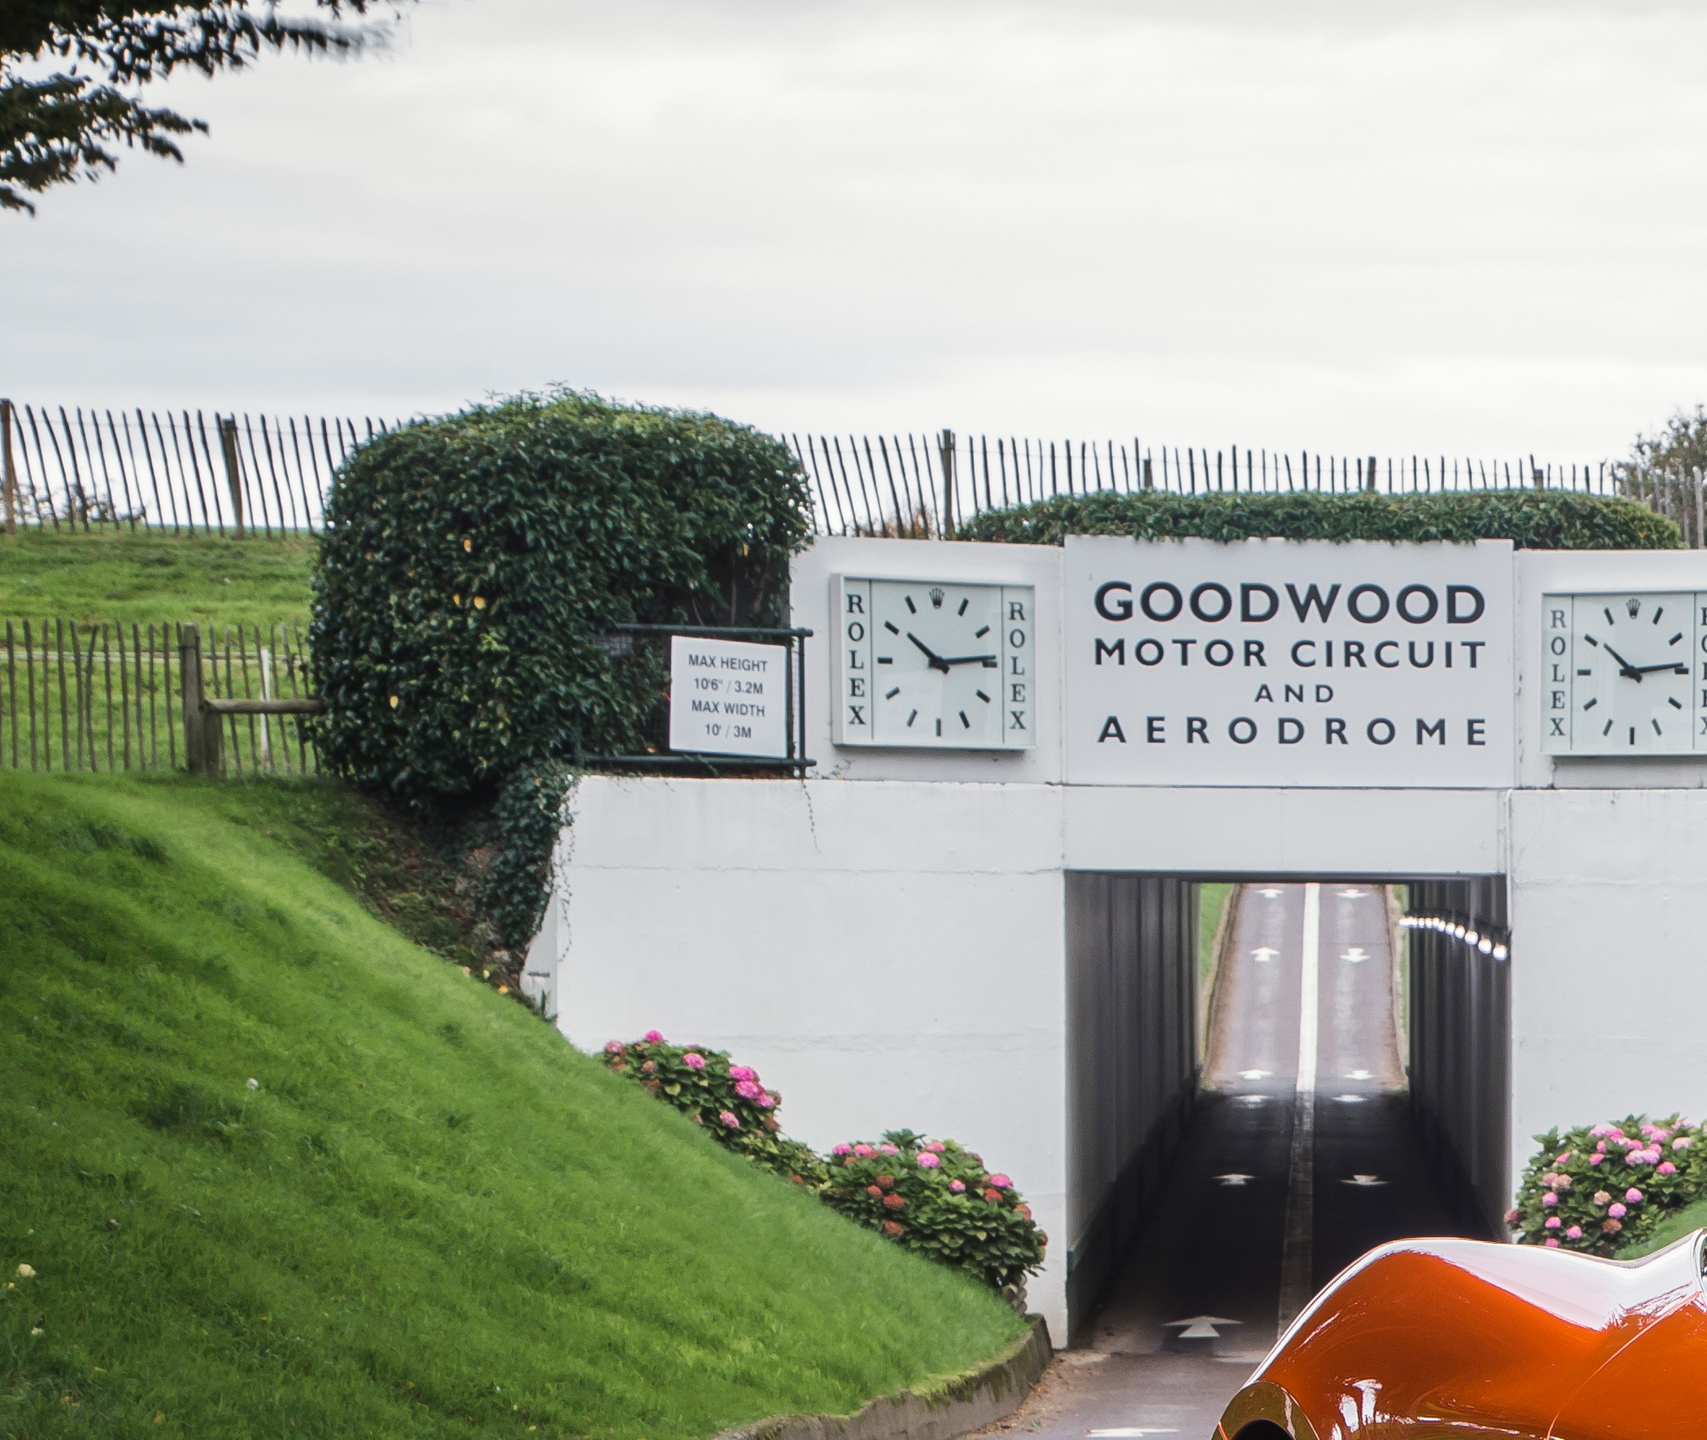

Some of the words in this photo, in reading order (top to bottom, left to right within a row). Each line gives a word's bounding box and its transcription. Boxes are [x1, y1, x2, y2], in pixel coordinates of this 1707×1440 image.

[1094, 580, 1485, 624] GOODWOOD
[688, 654, 716, 668] MAX
[720, 657, 768, 673] HEIGHT
[846, 593, 866, 726] ROLEX
[1008, 601, 1027, 731] ROLEX
[1094, 637, 1267, 667] MOTOR
[1290, 639, 1486, 669] CIRCUIT
[734, 680, 764, 695] 3.2M
[1549, 609, 1567, 737] ROLEX
[691, 699, 720, 714] MAX
[723, 702, 765, 718] WIDTH
[1254, 684, 1334, 703] AND
[733, 725, 752, 739] 3M
[1097, 715, 1486, 746] AERODROME
